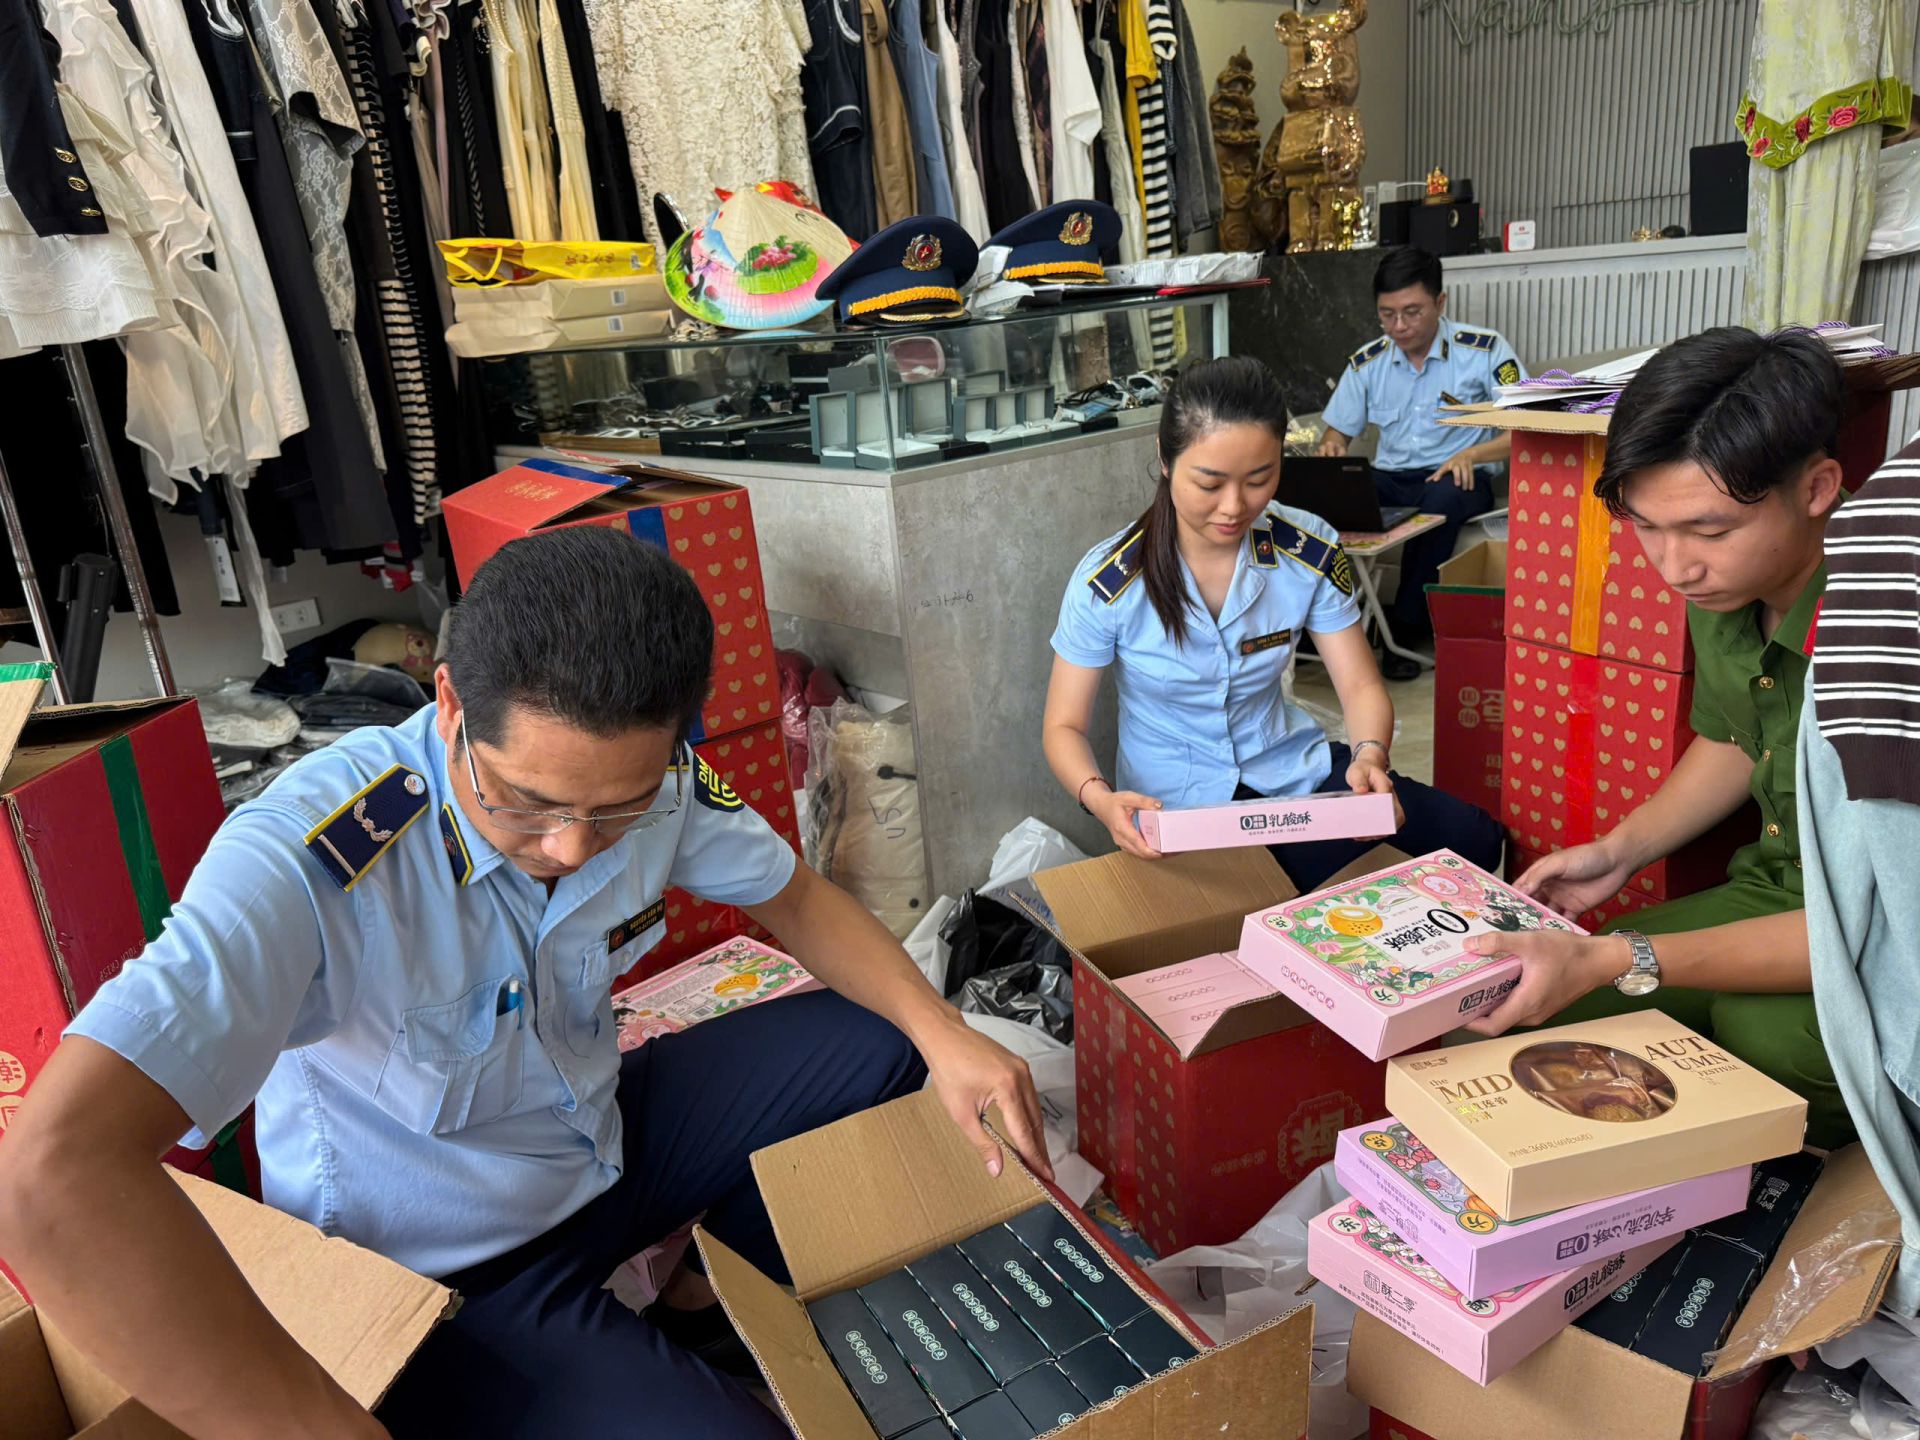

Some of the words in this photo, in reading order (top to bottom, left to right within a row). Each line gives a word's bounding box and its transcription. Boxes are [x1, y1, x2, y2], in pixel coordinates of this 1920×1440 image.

[1269, 811, 1312, 828] 乳酸酥
[1644, 1036, 1708, 1061] AUT
[1672, 1052, 1730, 1071] UMN
[1699, 1064, 1741, 1077] FESTIVAL
[1429, 1077, 1449, 1087] the
[1435, 1073, 1513, 1104] MID
[1592, 1206, 1676, 1248] 芋泥流心酥
